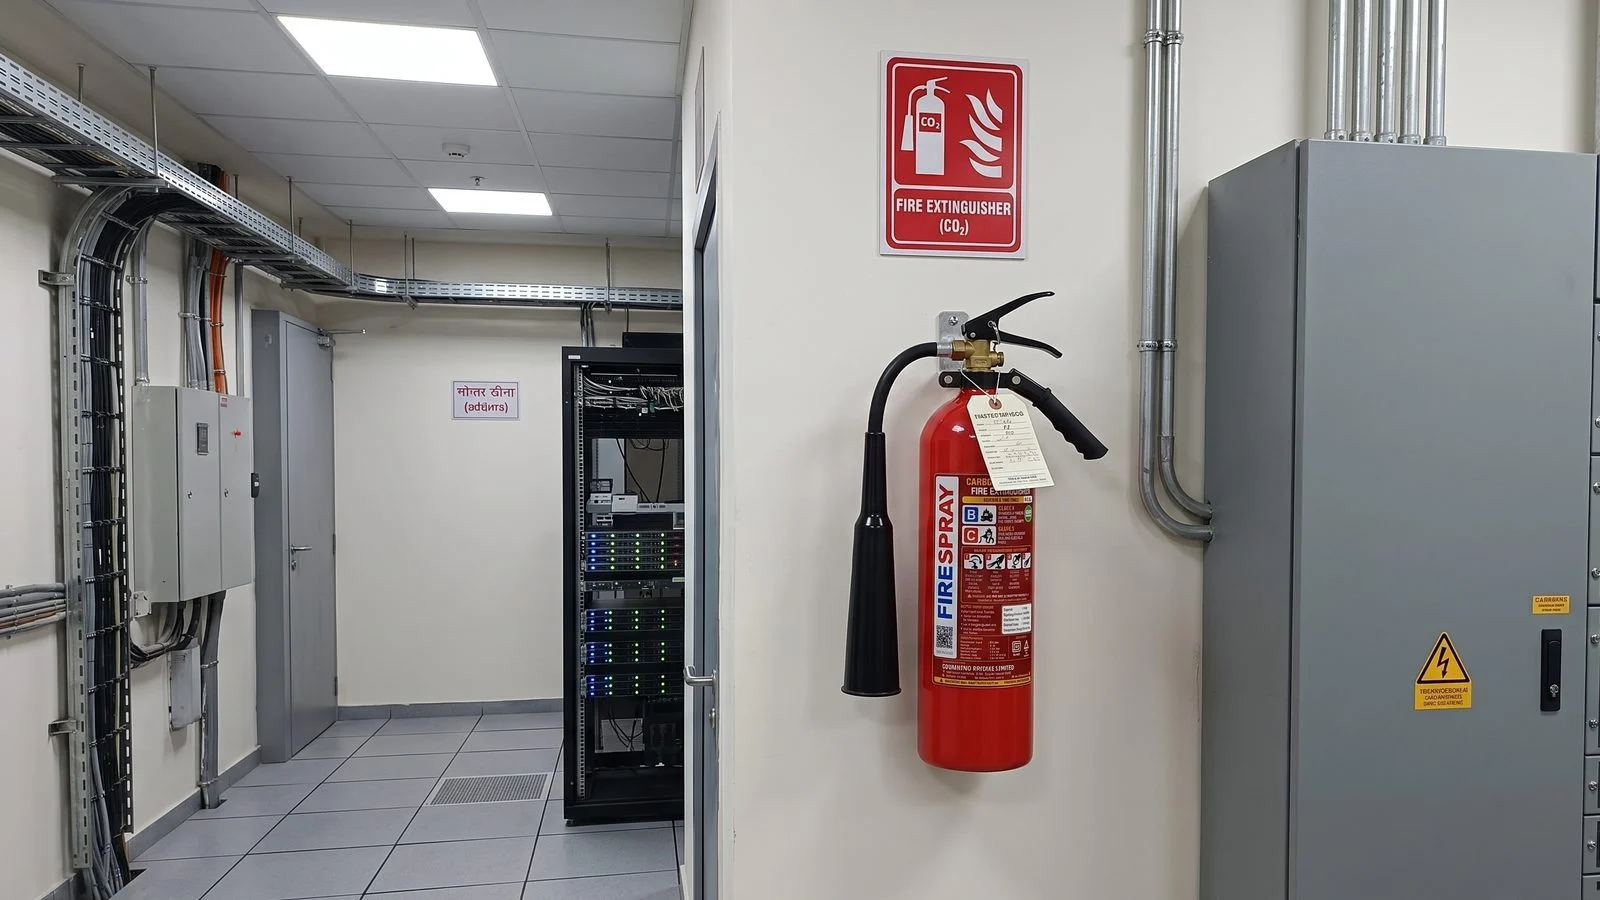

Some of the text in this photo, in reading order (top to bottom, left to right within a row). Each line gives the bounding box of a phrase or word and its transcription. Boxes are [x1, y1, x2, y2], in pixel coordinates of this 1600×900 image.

[896, 198, 1011, 216] FIRE EXTINGUISHER
[971, 487, 988, 496] FIRE
[967, 509, 976, 520] B
[966, 531, 976, 542] C
[937, 483, 954, 620] FIRESPRAY
